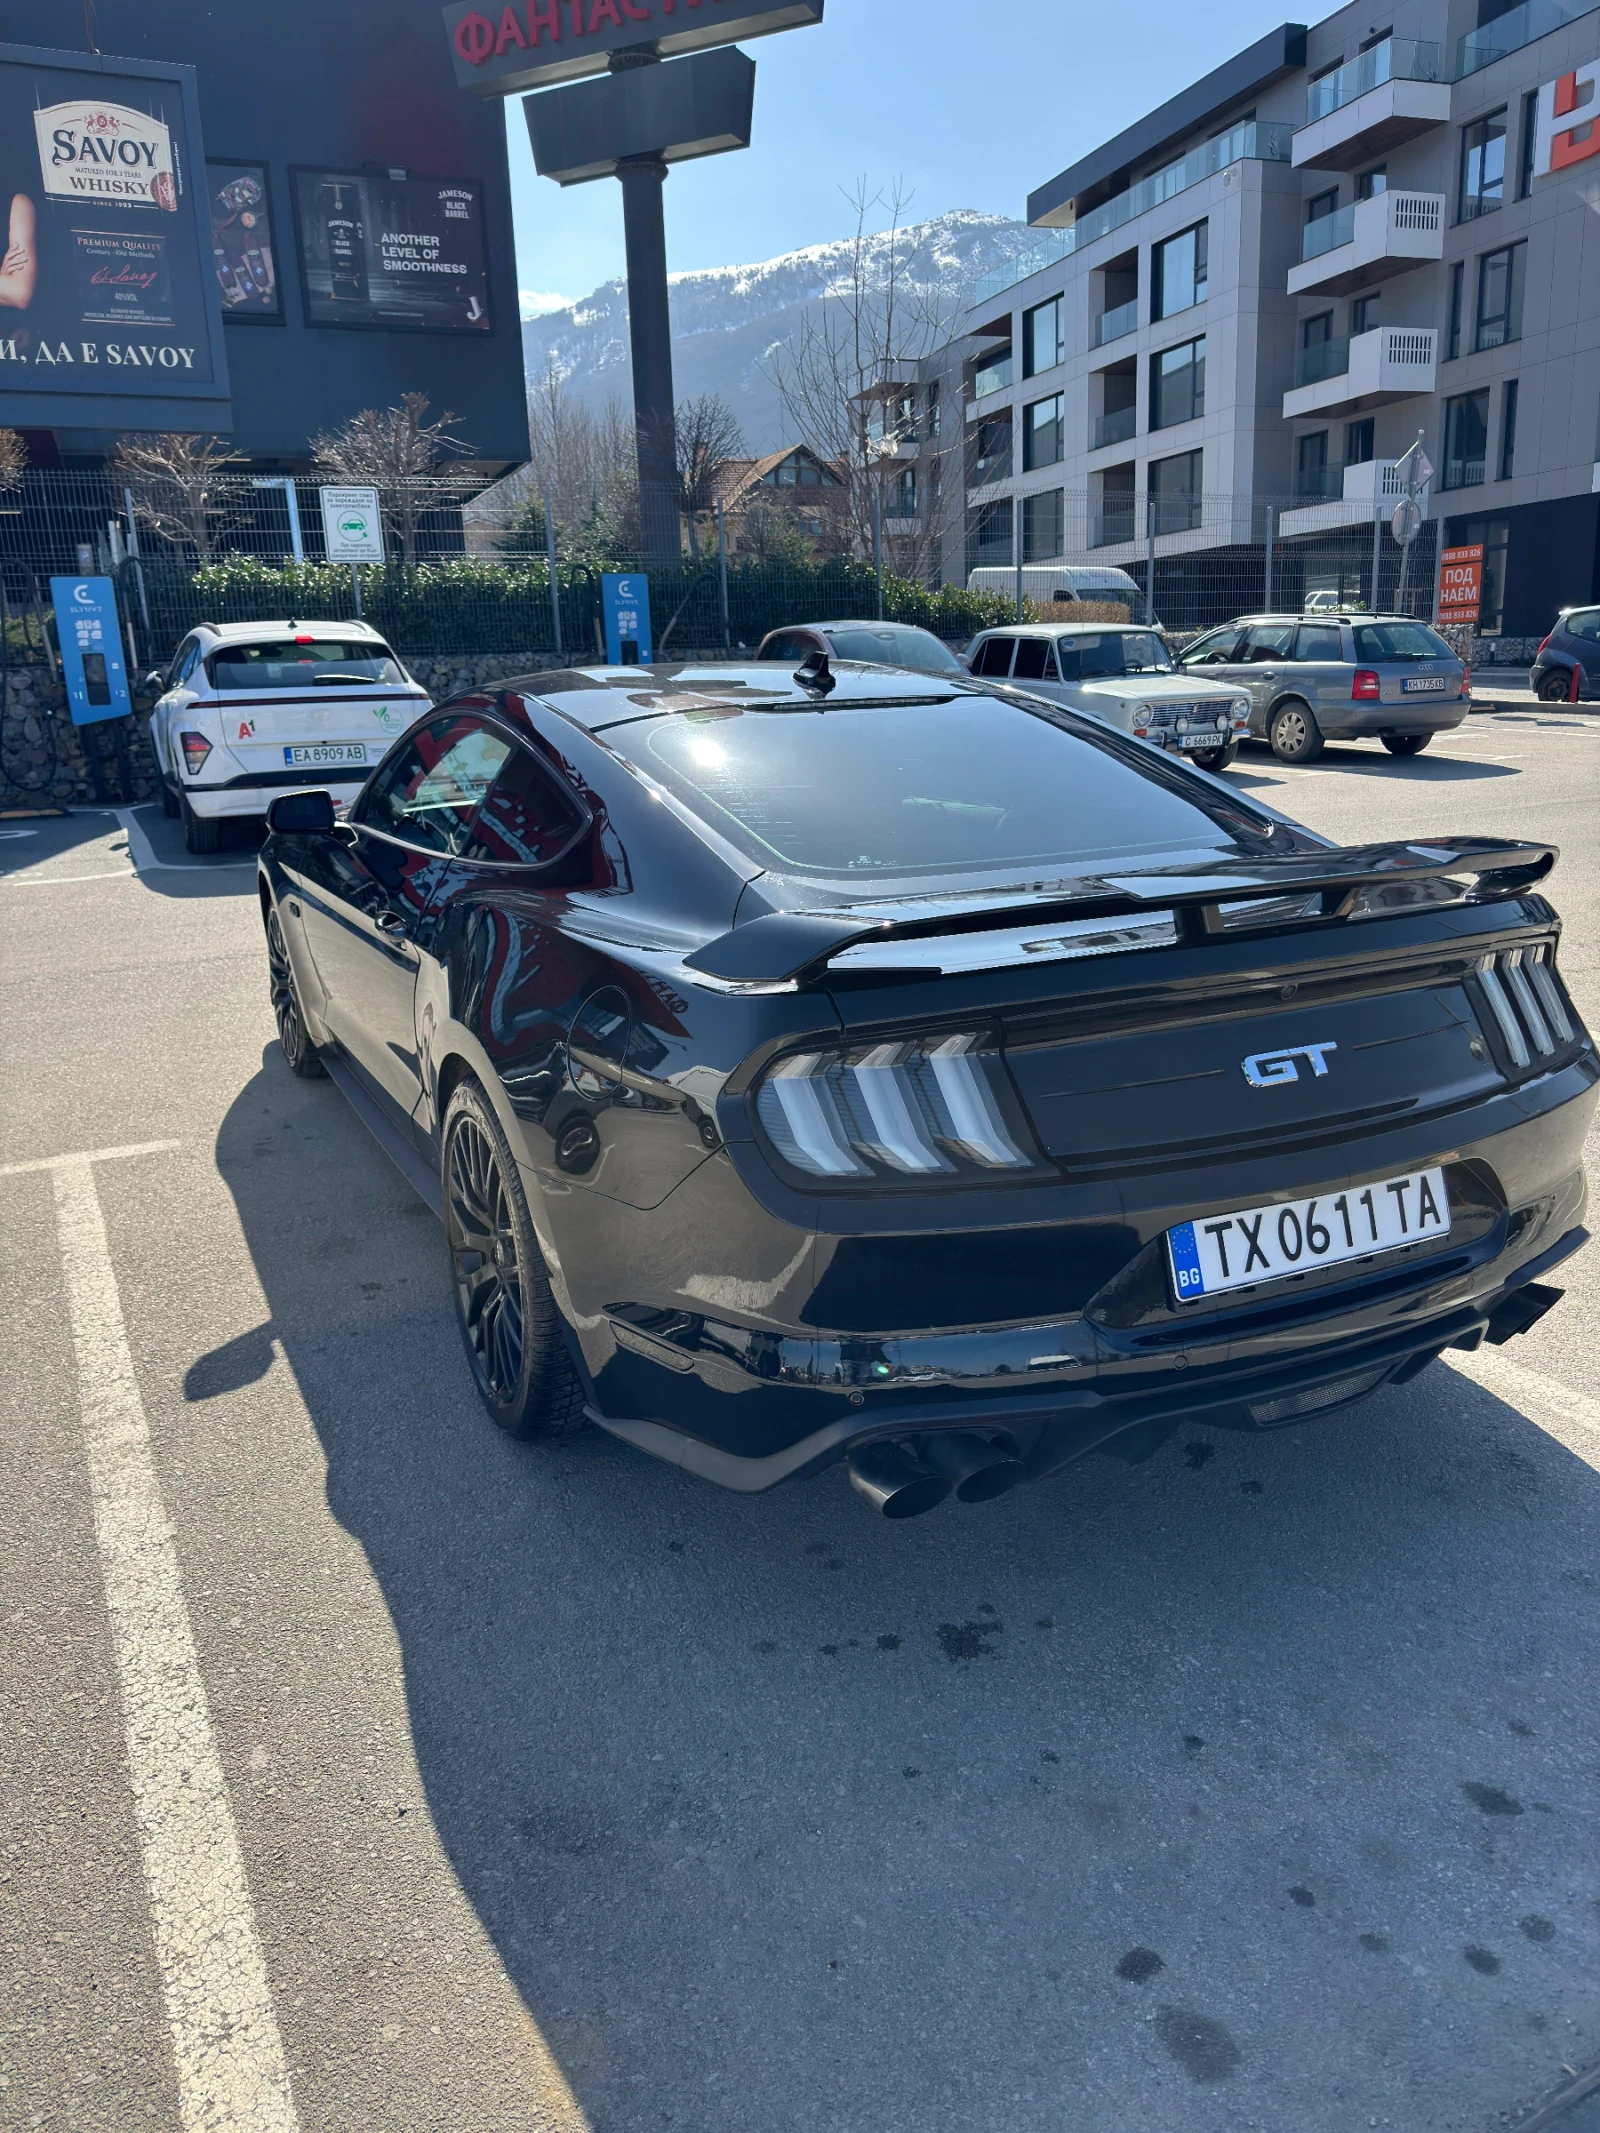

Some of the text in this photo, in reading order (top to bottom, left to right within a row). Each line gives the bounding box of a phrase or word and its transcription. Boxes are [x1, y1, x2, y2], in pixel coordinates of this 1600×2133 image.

[454, 0, 723, 64] ФАНТА
[52, 129, 158, 168] SAVOY
[75, 167, 105, 175] MATURED
[123, 170, 142, 178] YEARS
[69, 176, 149, 195] WHISKY
[437, 189, 473, 201] JAMESON
[446, 201, 466, 210] BLACK
[445, 209, 470, 219] BARREL
[77, 236, 161, 251] PREMIUM QUALITY
[381, 232, 440, 247] ANOTHER
[381, 246, 440, 260] LEVEL OF
[383, 259, 468, 275] SMOOTHNESS
[466, 296, 481, 320] J
[35, 340, 75, 366] ДА
[106, 344, 195, 368] SAVOY
[1457, 550, 1468, 559] 833
[1469, 548, 1481, 557] 826
[1445, 567, 1473, 586] ПОД
[1440, 585, 1477, 603] НАЕМ
[1453, 610, 1465, 619] 833
[1466, 609, 1477, 618] 826
[293, 749, 312, 762] EA
[313, 747, 344, 761] 8909
[346, 746, 363, 760] AB
[1240, 1041, 1338, 1088] GT
[1179, 1267, 1200, 1287] BG
